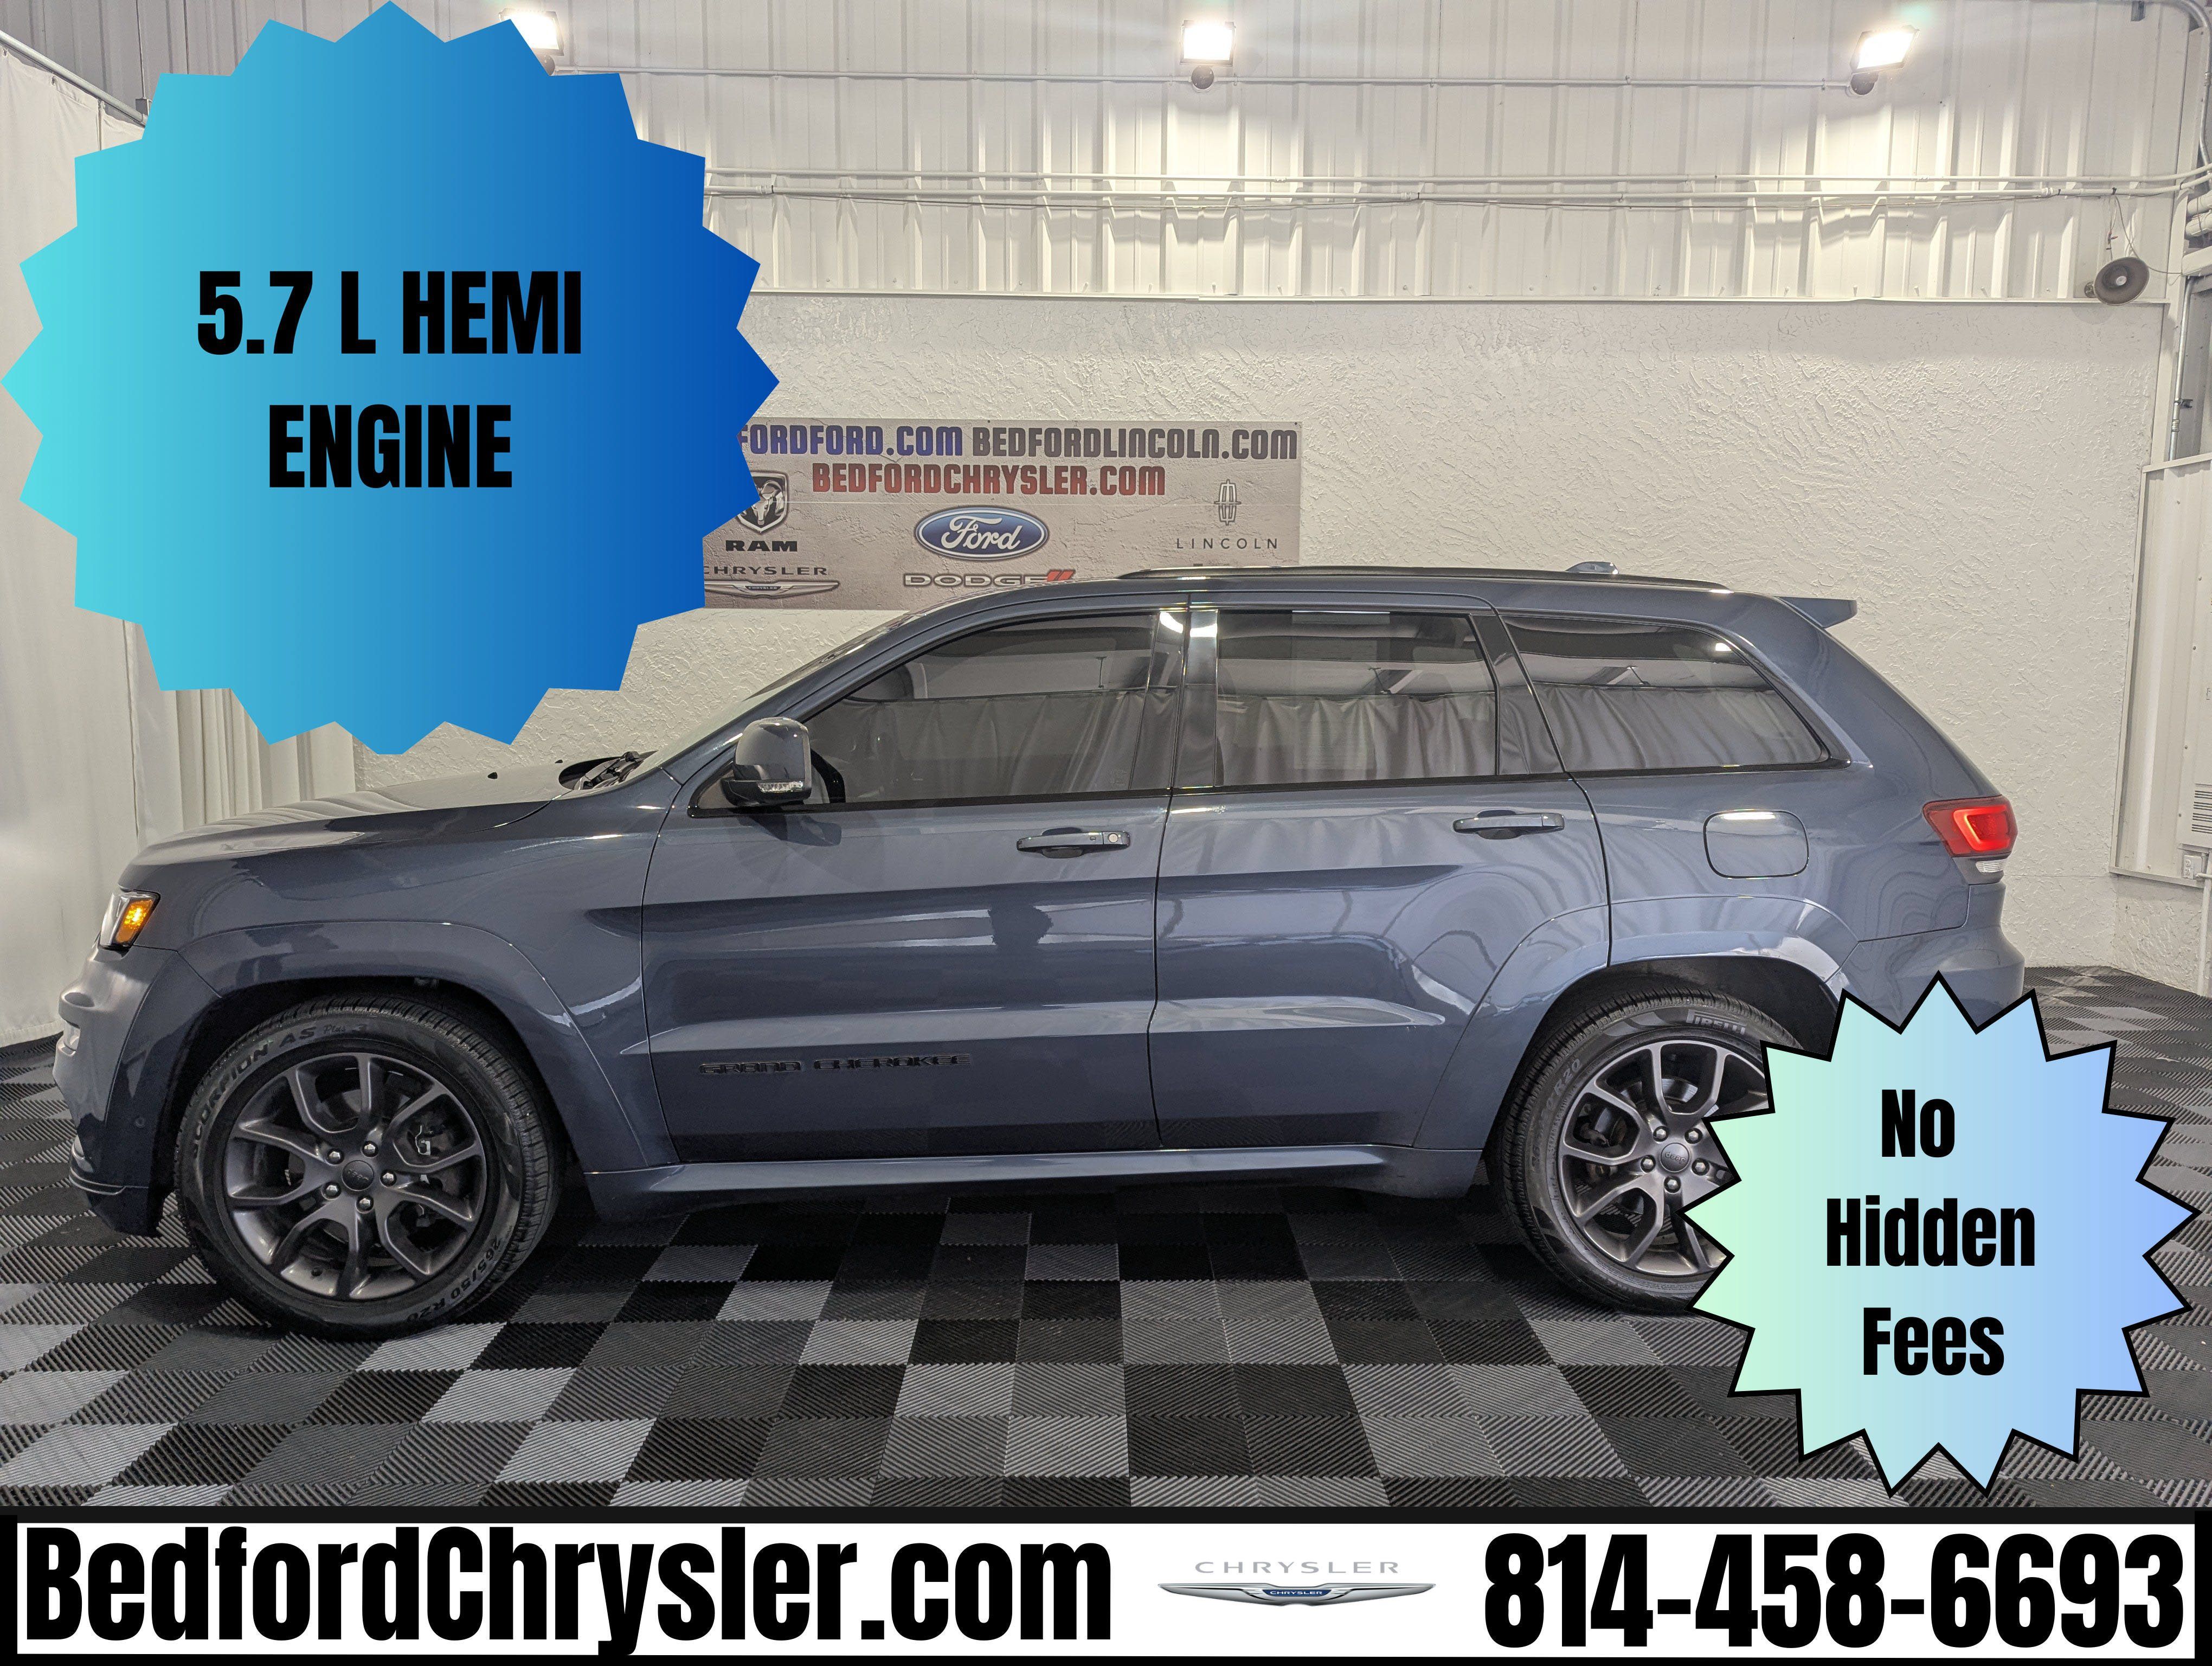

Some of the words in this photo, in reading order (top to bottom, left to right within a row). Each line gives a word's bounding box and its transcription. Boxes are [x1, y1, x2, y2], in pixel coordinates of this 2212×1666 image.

[972, 426, 1297, 460] BEDFORDLINCOLN.COM
[813, 463, 1166, 496] BEDFORDCHRYSLER.COM
[941, 515, 1023, 550] Ford
[1176, 538, 1277, 549] LINCOLN
[725, 540, 798, 552] RAM
[1686, 1009, 1747, 1035] PIRELLI
[279, 1026, 317, 1048] AS
[698, 1061, 802, 1074] GRAND
[813, 1054, 971, 1070] CHEROKEE
